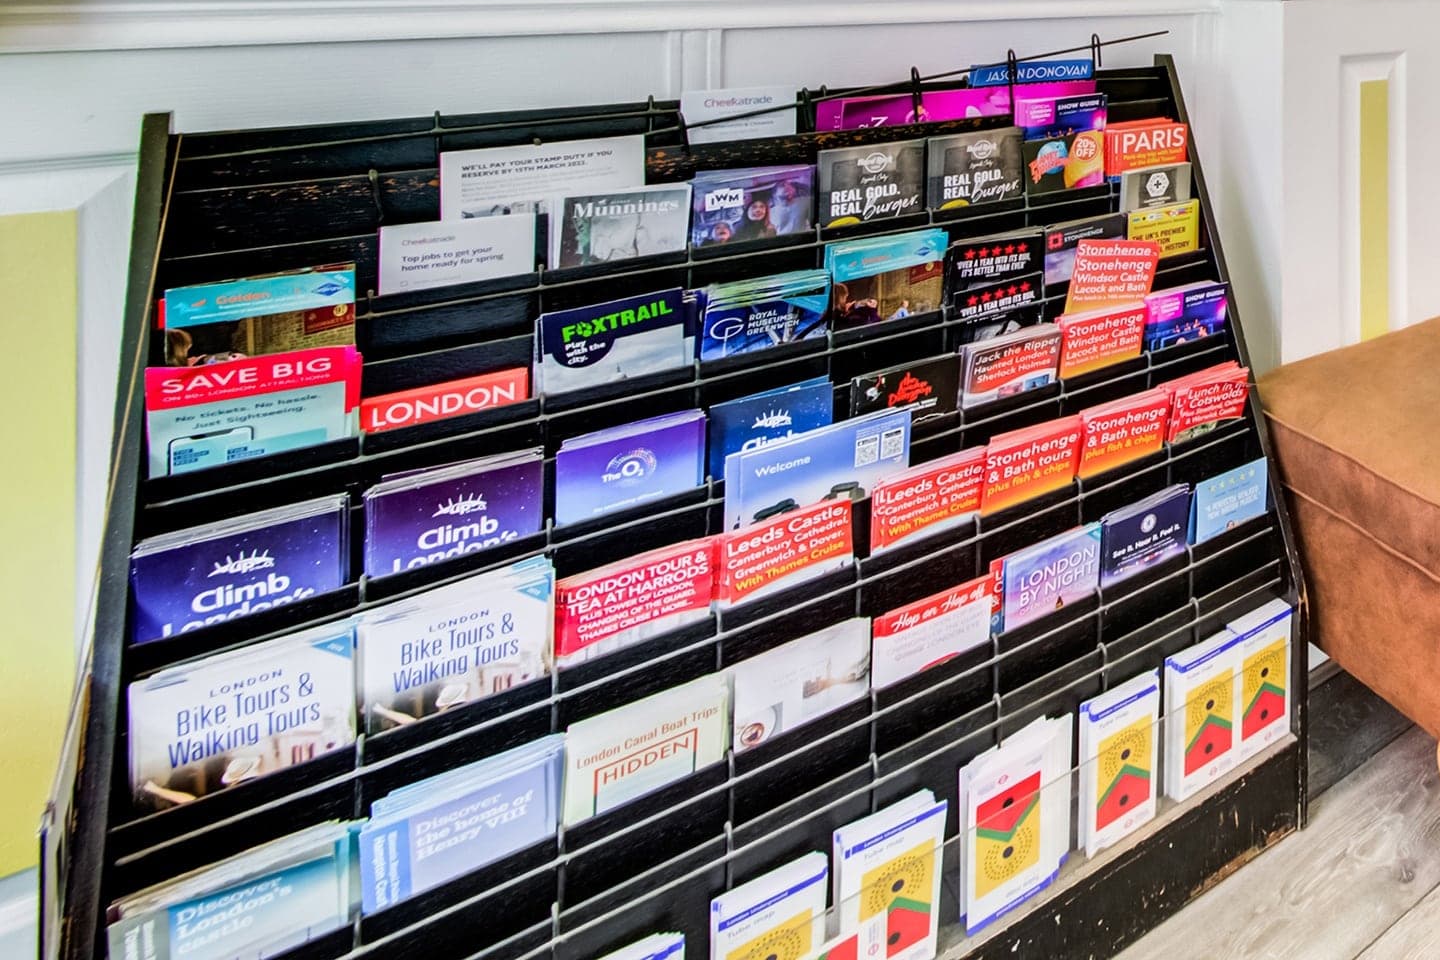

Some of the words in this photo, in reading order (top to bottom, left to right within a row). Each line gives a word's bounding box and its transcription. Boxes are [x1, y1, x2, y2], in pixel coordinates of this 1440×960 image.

[1026, 65, 1089, 79] DONOVAN
[1075, 147, 1095, 158] OFF
[1076, 138, 1096, 149] 20%
[1122, 127, 1185, 154] PARIS
[534, 155, 562, 164] STAMP
[563, 153, 586, 162] DUTY
[943, 185, 971, 199] REAL
[971, 178, 1019, 203] Burger.
[944, 172, 971, 187] REAL
[974, 169, 1004, 184] GOLD.
[710, 192, 741, 206] IWM
[831, 190, 863, 204] REAL
[866, 183, 901, 199] GOLD.
[831, 202, 862, 217] REAL
[862, 194, 919, 220] Burger.
[573, 198, 680, 219] Munnings
[401, 263, 430, 272] home
[431, 259, 458, 270] ready
[460, 256, 474, 265] for
[476, 253, 504, 264] spring
[402, 255, 419, 264] Top
[421, 252, 441, 261] jobs
[455, 248, 470, 258] get
[472, 246, 493, 255] your
[1079, 259, 1152, 272] Stonehenge
[1074, 284, 1107, 294] Lacock
[1108, 284, 1125, 292] and
[1126, 282, 1147, 291] Bath
[1076, 273, 1118, 283] Windsor
[1119, 272, 1149, 282] Castle
[561, 299, 673, 343] FOXTRAIL
[748, 313, 792, 328] MUSEUMS
[749, 309, 777, 320] ROYAL
[1068, 313, 1144, 338] Stonehenge
[564, 340, 586, 352] Play
[565, 346, 588, 358] with
[589, 341, 606, 351] the
[975, 352, 1002, 366] Jack
[1003, 345, 1022, 357] the
[1024, 336, 1060, 352] Ripper
[1065, 346, 1098, 360] Lacock
[1100, 340, 1117, 351] and
[1119, 335, 1140, 346] Bath
[1067, 333, 1109, 350] Windsor
[1111, 325, 1141, 338] Castle
[161, 367, 259, 394] SAVE
[272, 357, 333, 379] BIG
[973, 359, 1014, 376] Haunted
[1014, 350, 1048, 364] London
[976, 368, 1016, 384] Sherlock
[1017, 358, 1051, 371] Holmes
[371, 381, 516, 428] LONDON
[1188, 383, 1220, 400] Lunch
[1190, 388, 1243, 408] Cotswolds
[175, 415, 196, 423] No
[255, 400, 275, 409] No
[1087, 406, 1167, 434] Stonehenge
[1085, 448, 1105, 461] plus
[1106, 441, 1123, 453] fish
[1133, 433, 1157, 447] chips
[1087, 436, 1097, 447] &
[1101, 427, 1129, 444] Bath
[1130, 420, 1160, 437] tours
[986, 433, 1077, 469] Stonehenge
[601, 473, 621, 482] The
[754, 455, 811, 477] Welcome
[986, 481, 1011, 497] plus
[1012, 472, 1031, 487] fish
[1043, 460, 1071, 476] chips
[988, 472, 1000, 484] &
[1003, 461, 1035, 480] Bath
[1037, 448, 1073, 465] tours
[884, 492, 937, 516] Canterbury
[886, 479, 933, 504] Leeds
[888, 523, 912, 537] With
[913, 508, 949, 527] Thames
[950, 498, 978, 513] Cruise
[889, 501, 939, 526] Greenwich
[417, 515, 499, 550] Climb
[727, 527, 784, 558] Leeds
[788, 506, 848, 532] Castle,
[727, 538, 792, 569] Canterbury
[734, 548, 796, 579] Greenwich
[809, 530, 844, 548] Dover.
[735, 575, 764, 591] With
[766, 557, 809, 578] Thames
[811, 541, 844, 559] Cruise
[567, 568, 645, 604] LONDON
[647, 556, 693, 577] TOUR
[695, 551, 707, 562] &
[1020, 544, 1095, 591] LONDON
[191, 572, 291, 613] Climb
[567, 599, 602, 616] TEA
[604, 589, 627, 606] AT
[628, 563, 708, 598] HARRODS
[1019, 586, 1042, 608] BY
[1044, 560, 1095, 595] NIGHT
[428, 609, 490, 633] LONDON
[577, 611, 629, 633] CHANGING
[631, 606, 644, 614] OF
[645, 600, 662, 610] THE
[580, 612, 603, 623] PLUS
[604, 600, 638, 615] TOWER
[639, 595, 651, 603] OF
[891, 610, 920, 633] Hop
[922, 606, 938, 619] on
[940, 590, 968, 614] Hop
[969, 582, 985, 599] off
[401, 639, 443, 667] Bike
[449, 622, 495, 651] Tours
[501, 612, 514, 635] &
[579, 625, 619, 642] THAMES
[620, 615, 651, 632] CRUISE
[393, 655, 468, 694] Walking
[474, 639, 519, 667] Tours
[209, 668, 283, 698] LONDON
[176, 704, 227, 737] Bike
[235, 683, 290, 718] Tours
[298, 672, 314, 697] &
[167, 721, 259, 769] Walking
[267, 701, 321, 736] Tours
[576, 744, 622, 770] London
[624, 728, 659, 750] Canal
[660, 716, 688, 736] Boat
[690, 704, 720, 725] Trips
[603, 737, 690, 786] HIDDEN
[415, 793, 501, 835] Discover
[415, 826, 451, 848] the
[454, 803, 509, 835] home
[512, 790, 534, 808] of
[416, 826, 482, 862] Henry
[485, 805, 527, 828] VIII
[176, 877, 282, 925] Discover
